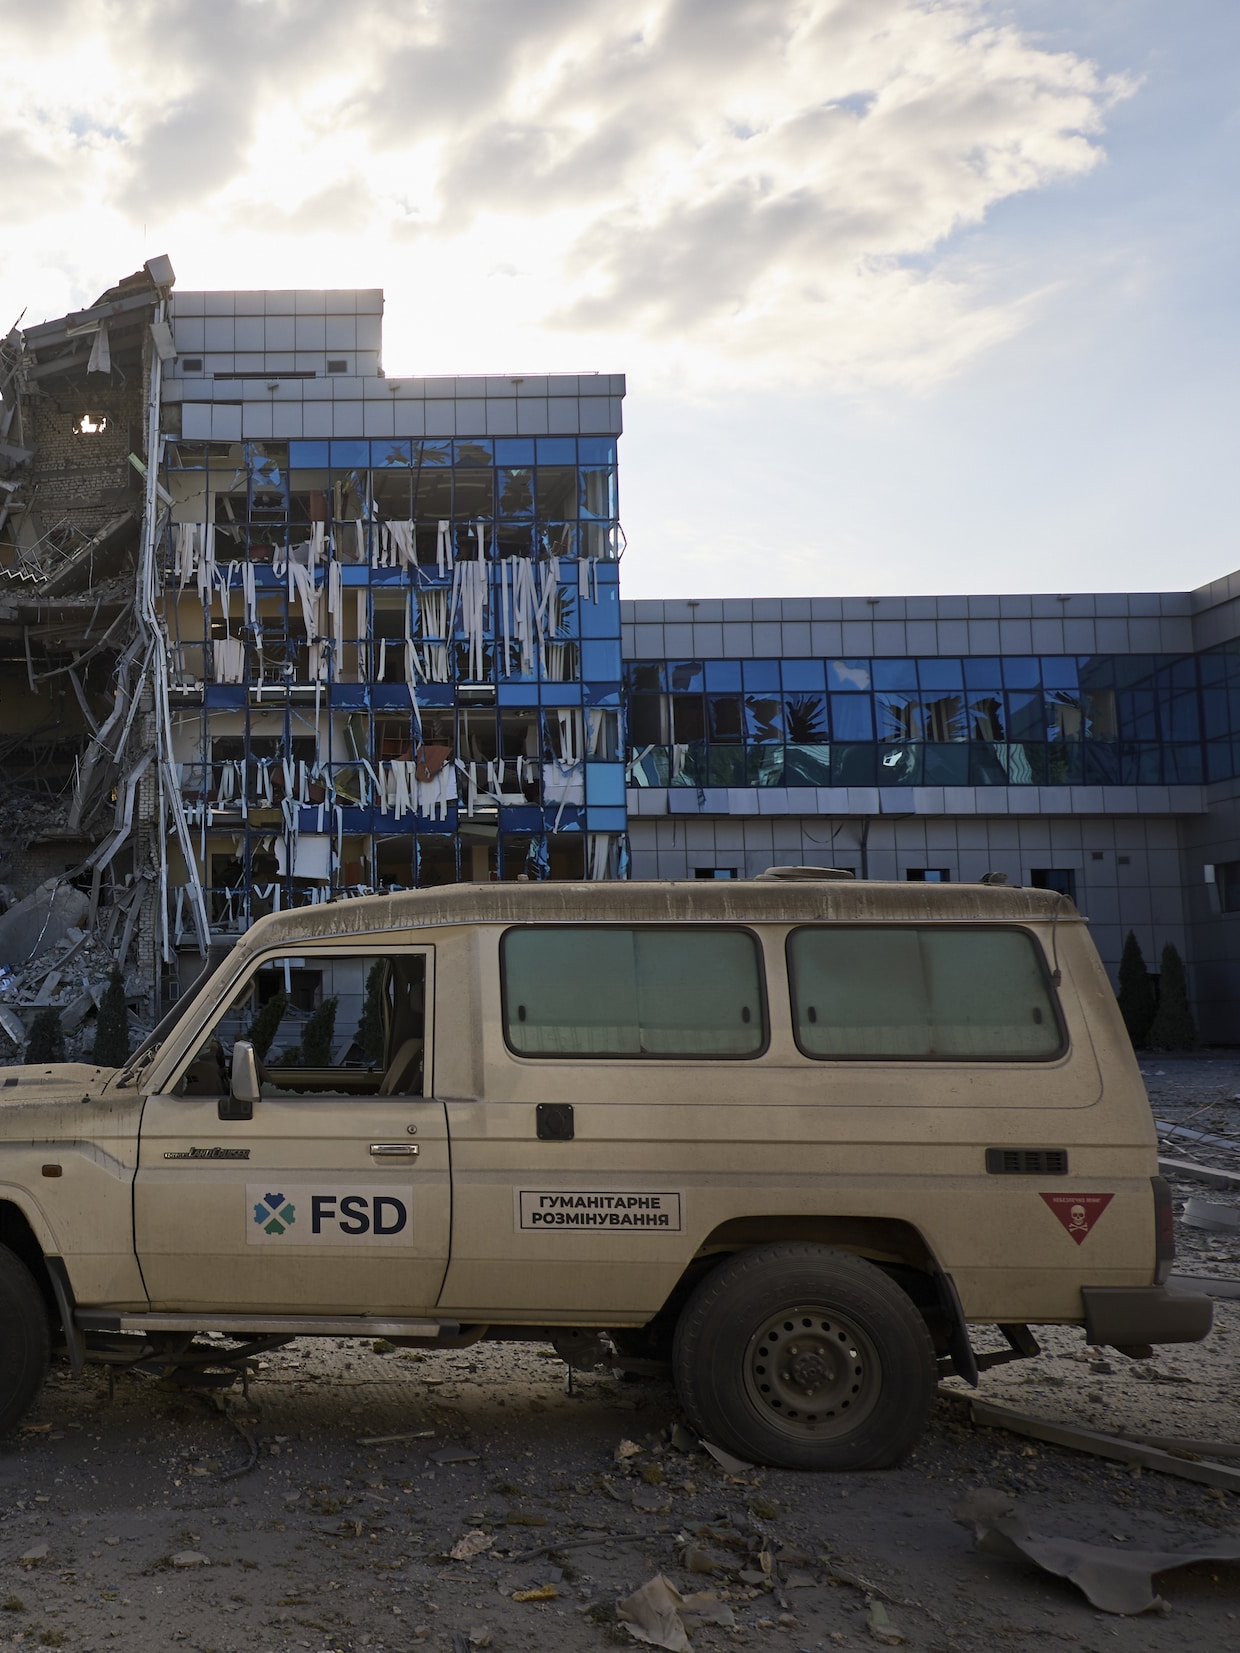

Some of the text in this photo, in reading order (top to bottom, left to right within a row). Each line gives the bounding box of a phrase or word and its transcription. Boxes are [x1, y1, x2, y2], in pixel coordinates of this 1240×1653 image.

[539, 1196, 661, 1209] ГУМАНІТАРНЕ
[311, 1195, 408, 1235] FSD
[532, 1212, 669, 1226] РОЗМІНУВАННЯ
